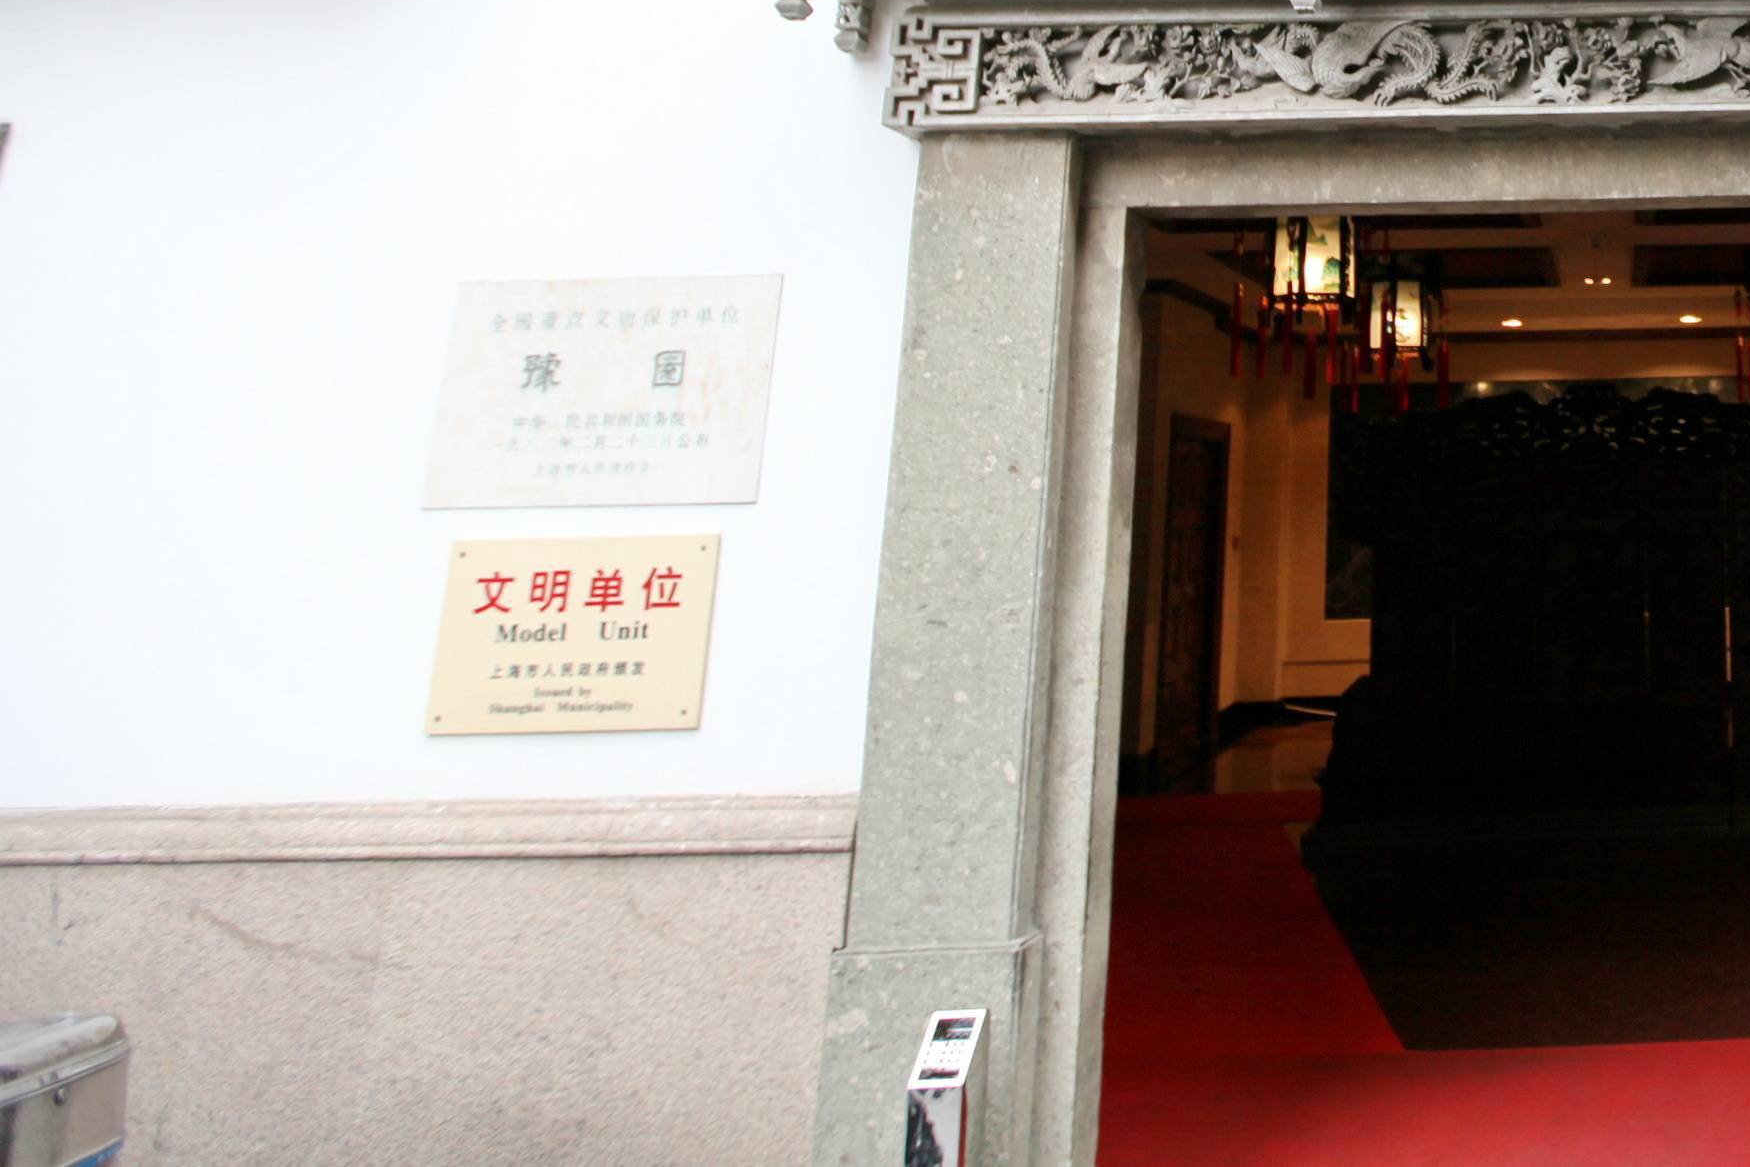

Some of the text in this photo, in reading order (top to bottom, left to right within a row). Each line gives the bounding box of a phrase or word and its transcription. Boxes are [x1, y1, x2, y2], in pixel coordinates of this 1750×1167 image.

[473, 566, 683, 614] 文明单位
[496, 620, 649, 644] Model Unit
[577, 686, 593, 700] by
[488, 700, 634, 715] Shanghai Municipality
